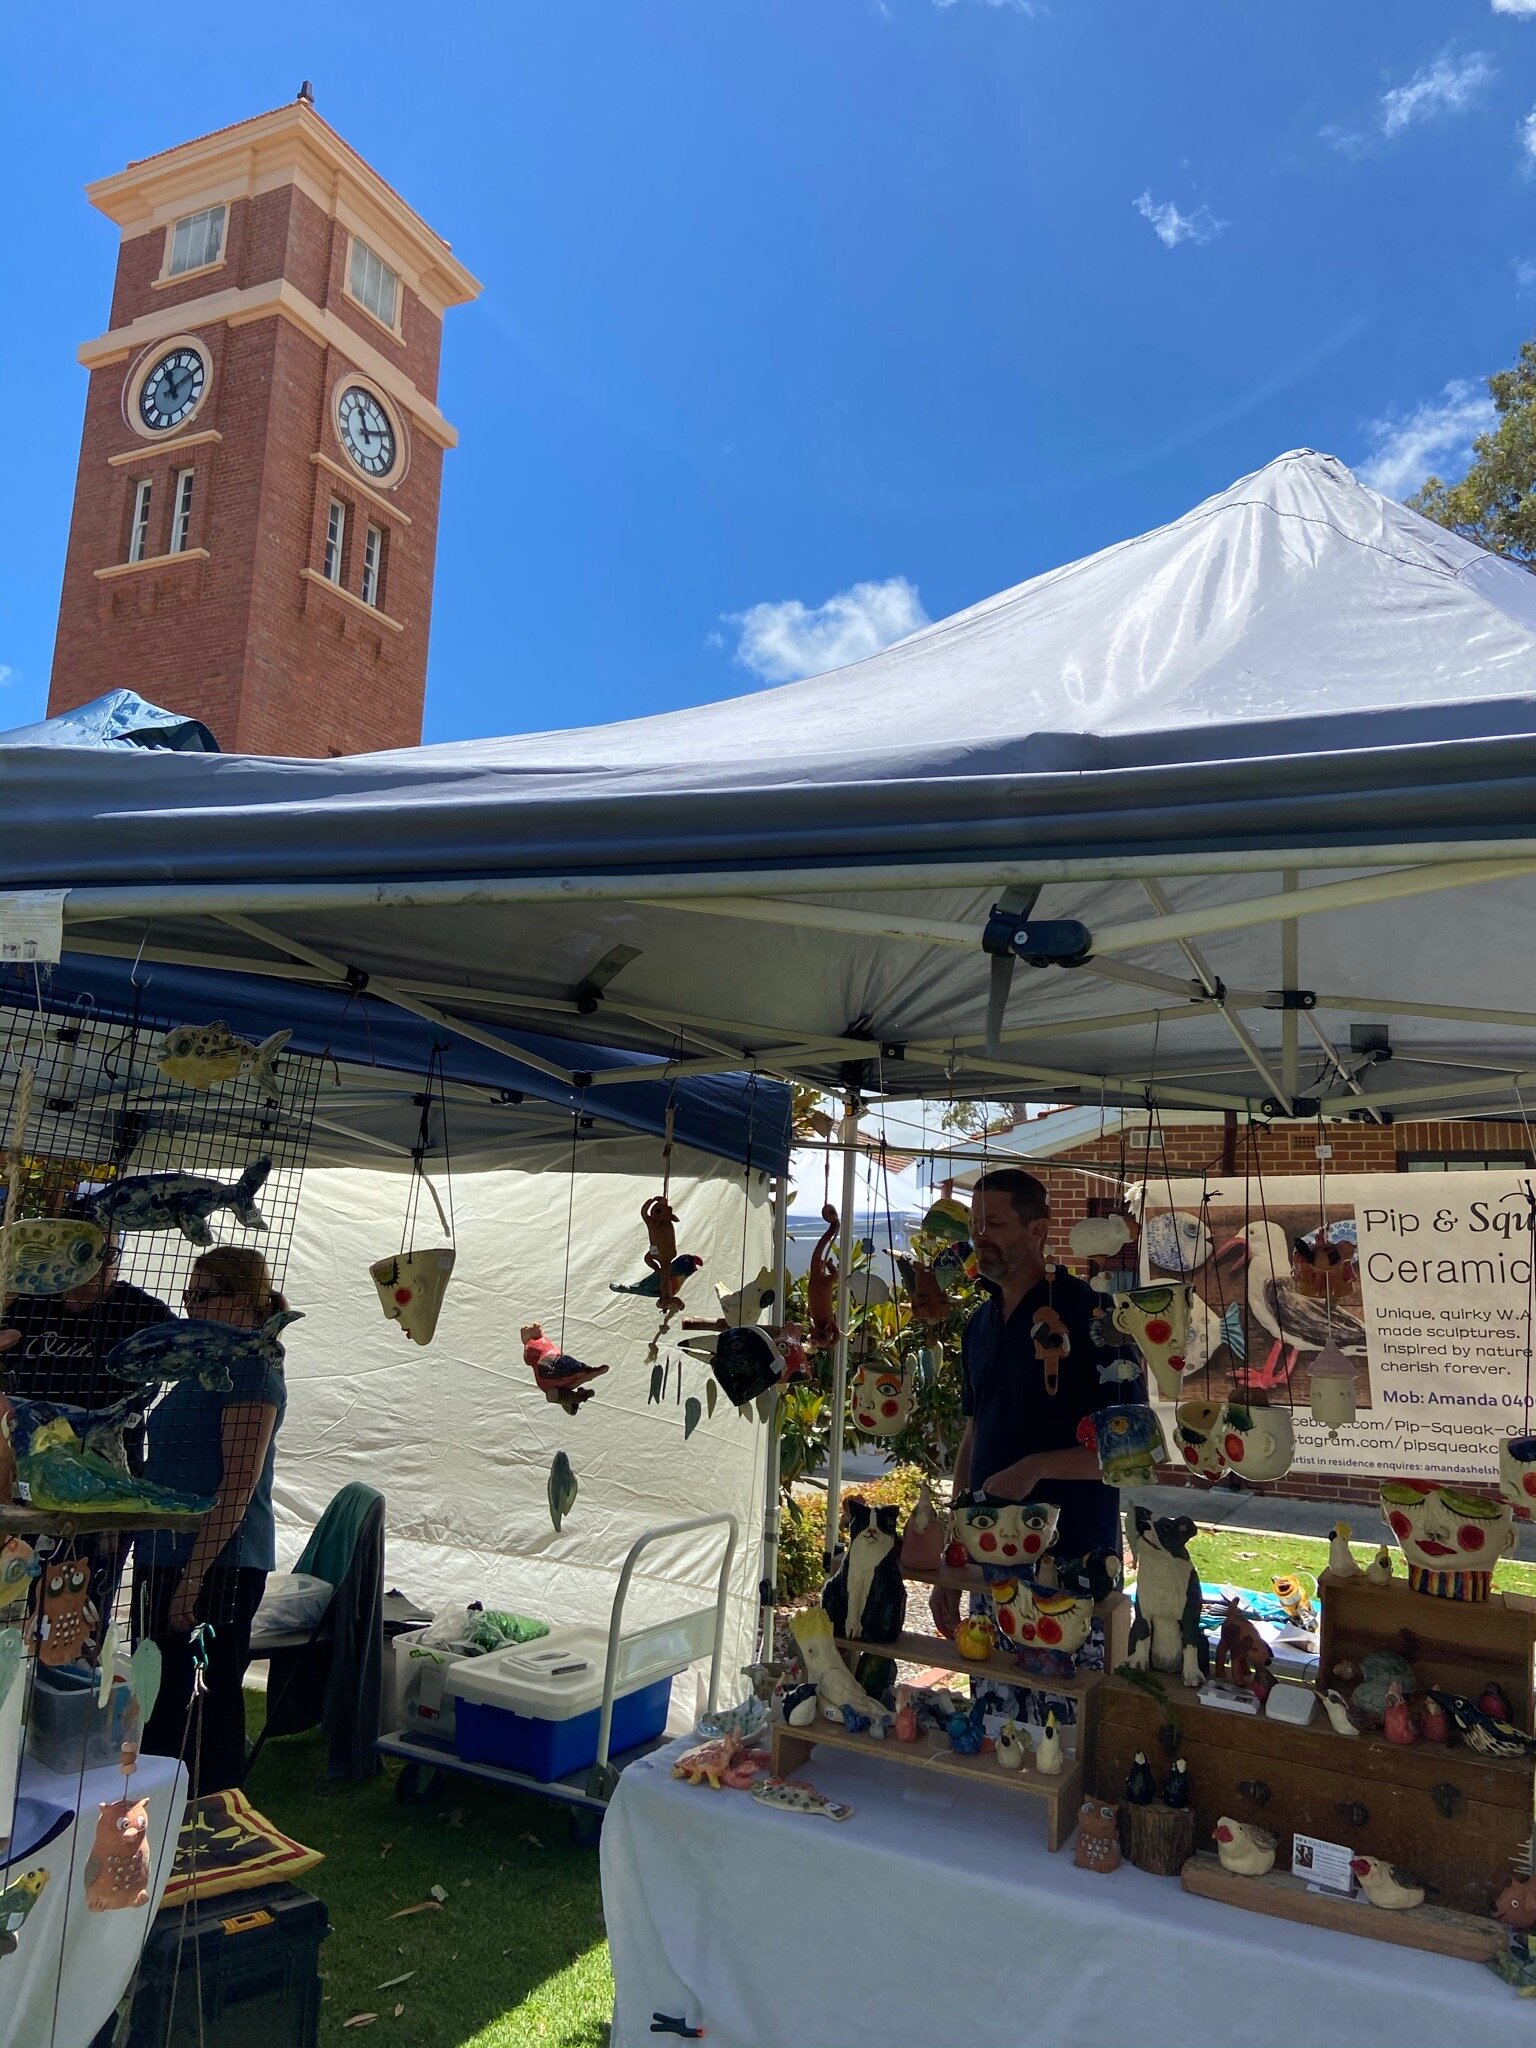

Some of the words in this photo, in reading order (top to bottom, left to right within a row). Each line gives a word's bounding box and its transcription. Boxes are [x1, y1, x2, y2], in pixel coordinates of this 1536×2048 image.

[1363, 1208, 1420, 1237] Pip
[1432, 1209, 1458, 1232] &
[1367, 1252, 1531, 1284] Ceramic
[1440, 1308, 1492, 1322] quirky
[1378, 1326, 1422, 1337] made
[1426, 1327, 1521, 1340] sculptures.
[1383, 1343, 1447, 1356] Inspired
[1452, 1345, 1471, 1358] by
[1476, 1347, 1533, 1357] nature
[1380, 1361, 1439, 1373] cherish
[1443, 1363, 1511, 1375] forever.
[1383, 1390, 1424, 1404] Mob:
[1428, 1392, 1498, 1407] Amanda
[1328, 1458, 1375, 1468] residence
[1376, 1461, 1423, 1471] enquires:
